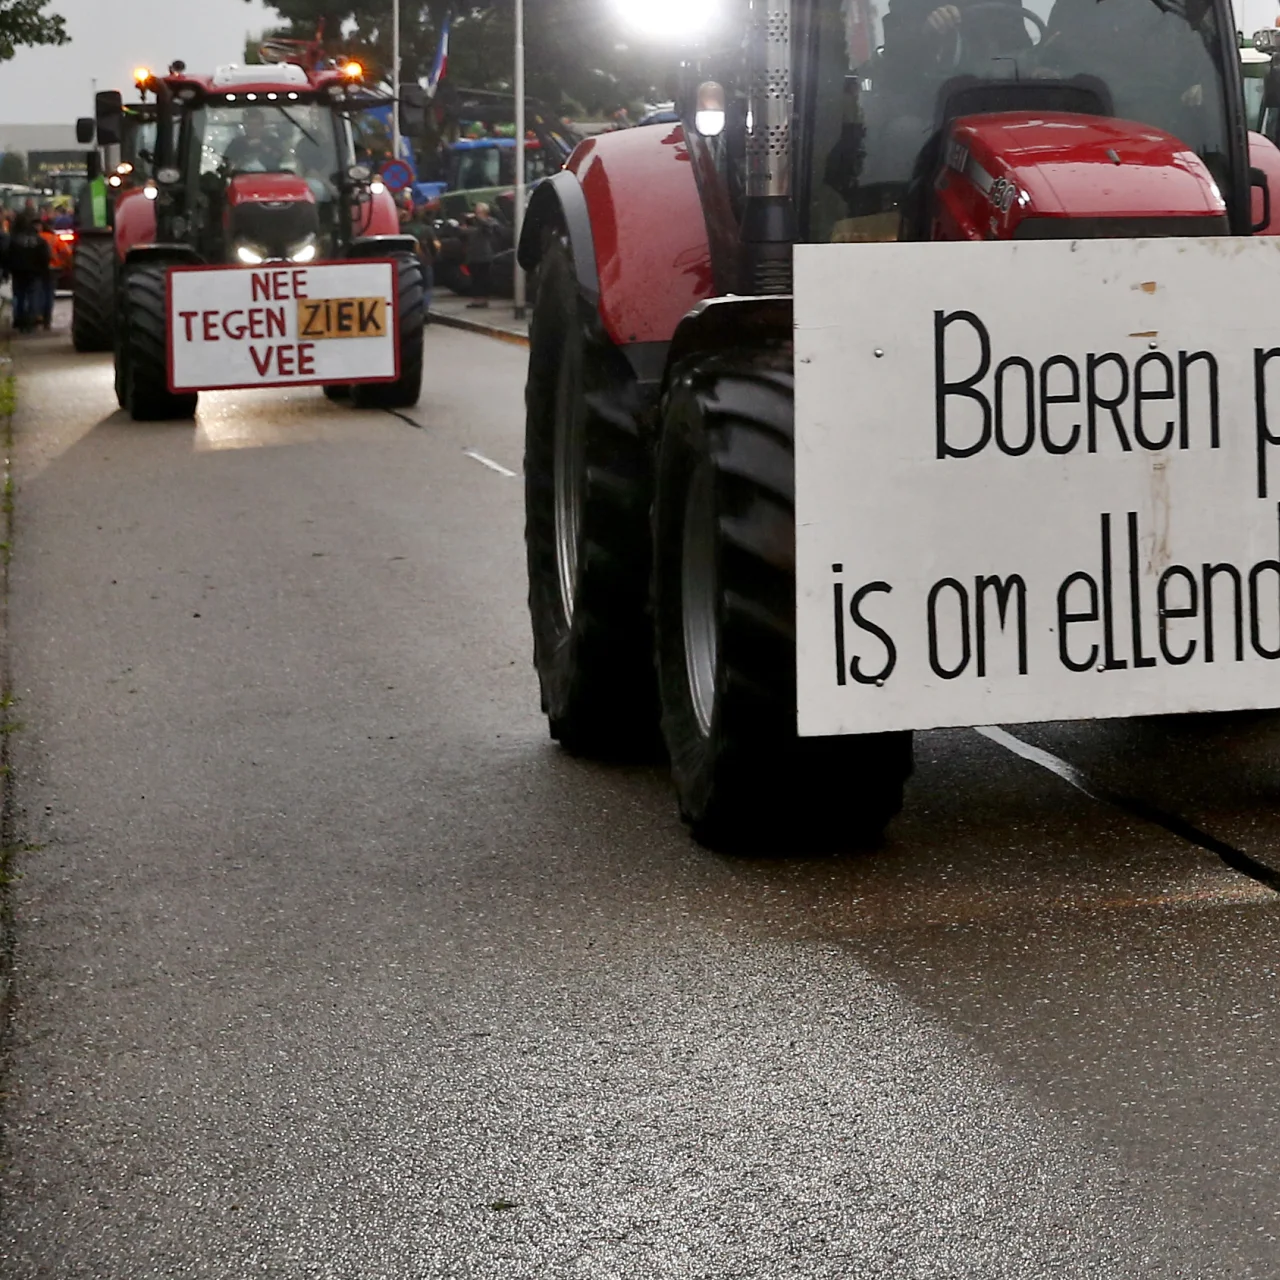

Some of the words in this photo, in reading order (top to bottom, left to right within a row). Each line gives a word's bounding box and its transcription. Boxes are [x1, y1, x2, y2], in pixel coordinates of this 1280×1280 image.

[251, 270, 308, 302] NEE
[178, 306, 286, 342] TEGEN
[249, 343, 316, 377] VEE
[831, 563, 897, 688] is
[926, 574, 1029, 681] om
